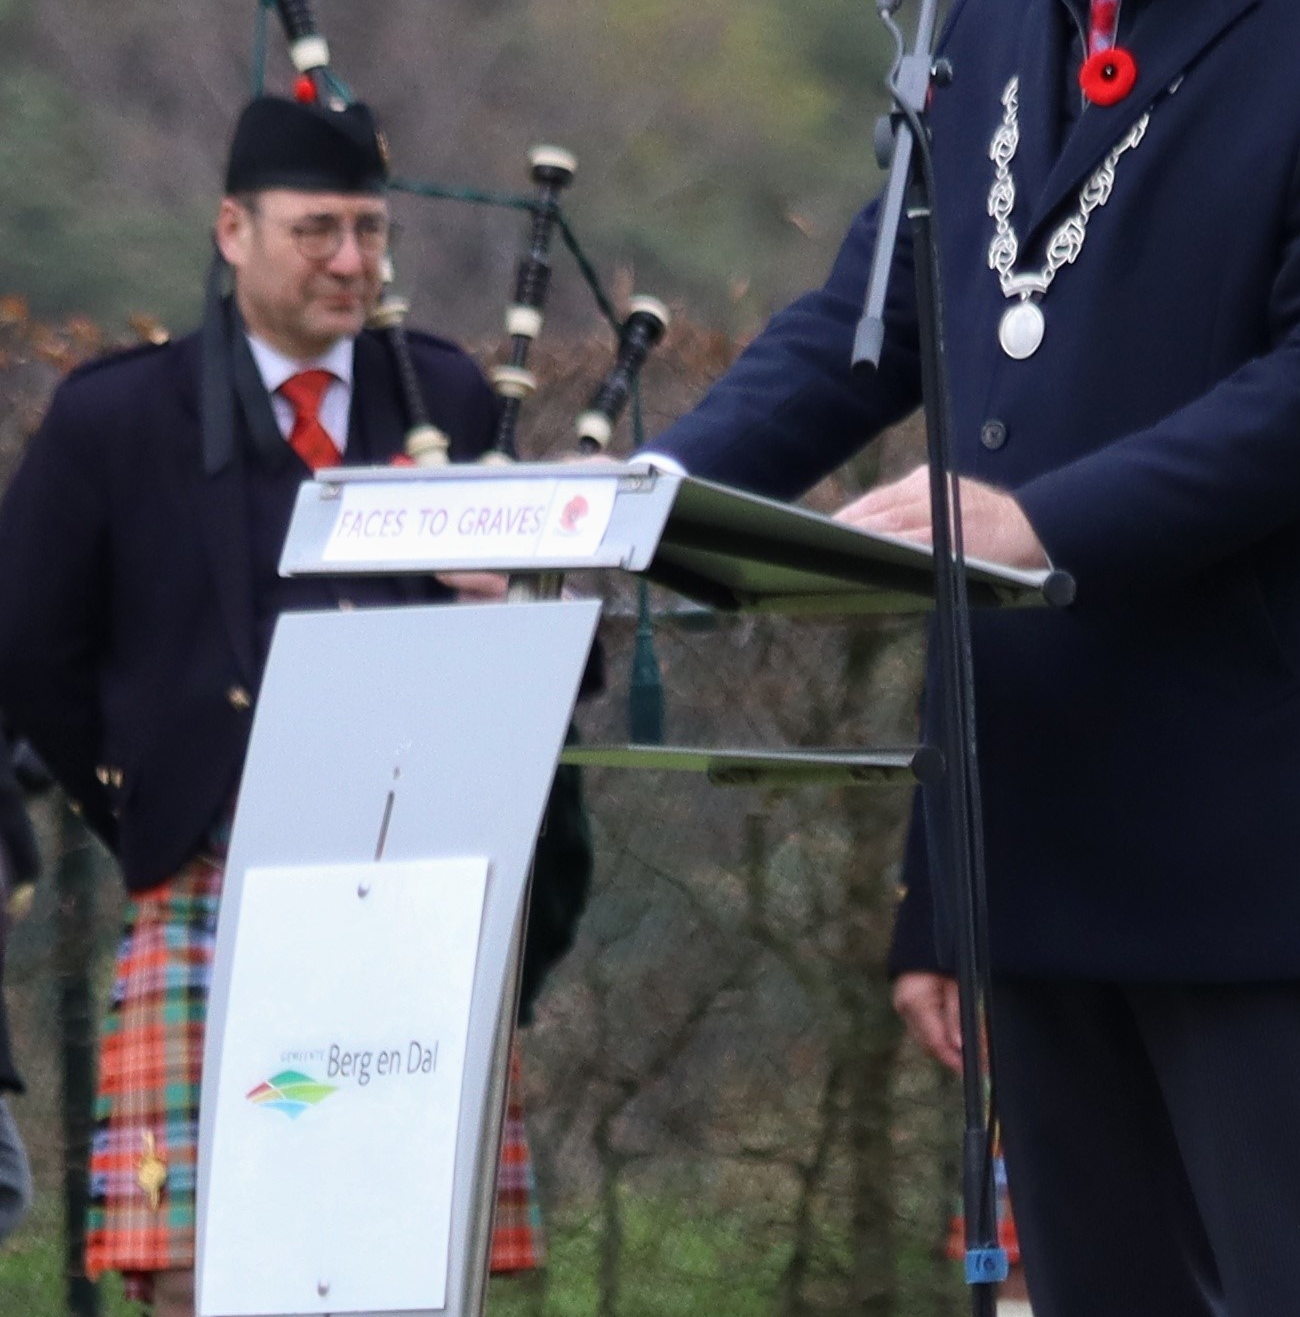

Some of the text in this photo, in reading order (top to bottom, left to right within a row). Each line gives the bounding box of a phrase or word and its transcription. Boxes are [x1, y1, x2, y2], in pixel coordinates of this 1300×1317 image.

[337, 505, 547, 539] FACES TO GRAVES
[327, 1043, 373, 1086] Berg
[376, 1048, 402, 1076] en
[406, 1040, 439, 1074] Dal
